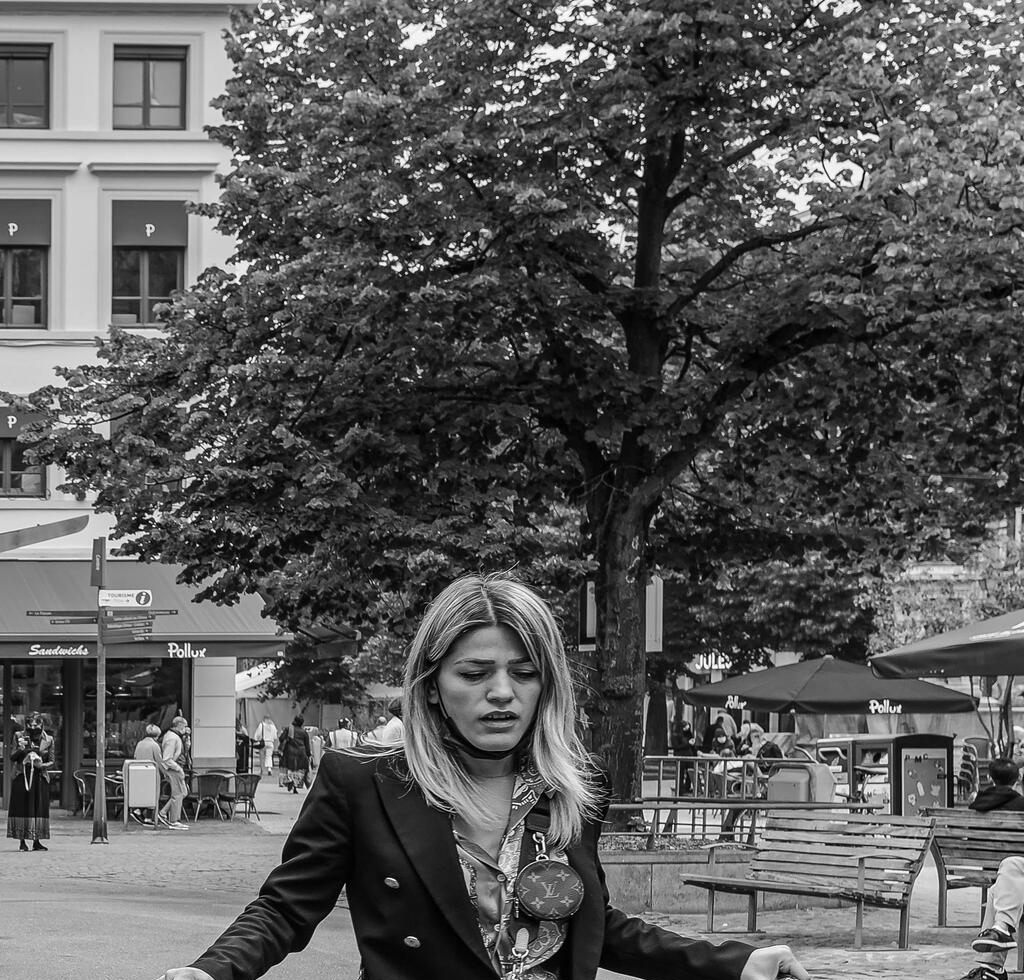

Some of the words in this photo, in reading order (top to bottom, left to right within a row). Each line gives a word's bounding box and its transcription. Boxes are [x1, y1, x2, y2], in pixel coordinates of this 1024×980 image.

[28, 644, 90, 656] Sandwichs
[167, 643, 207, 659] Pollux
[869, 698, 903, 714] Pollux
